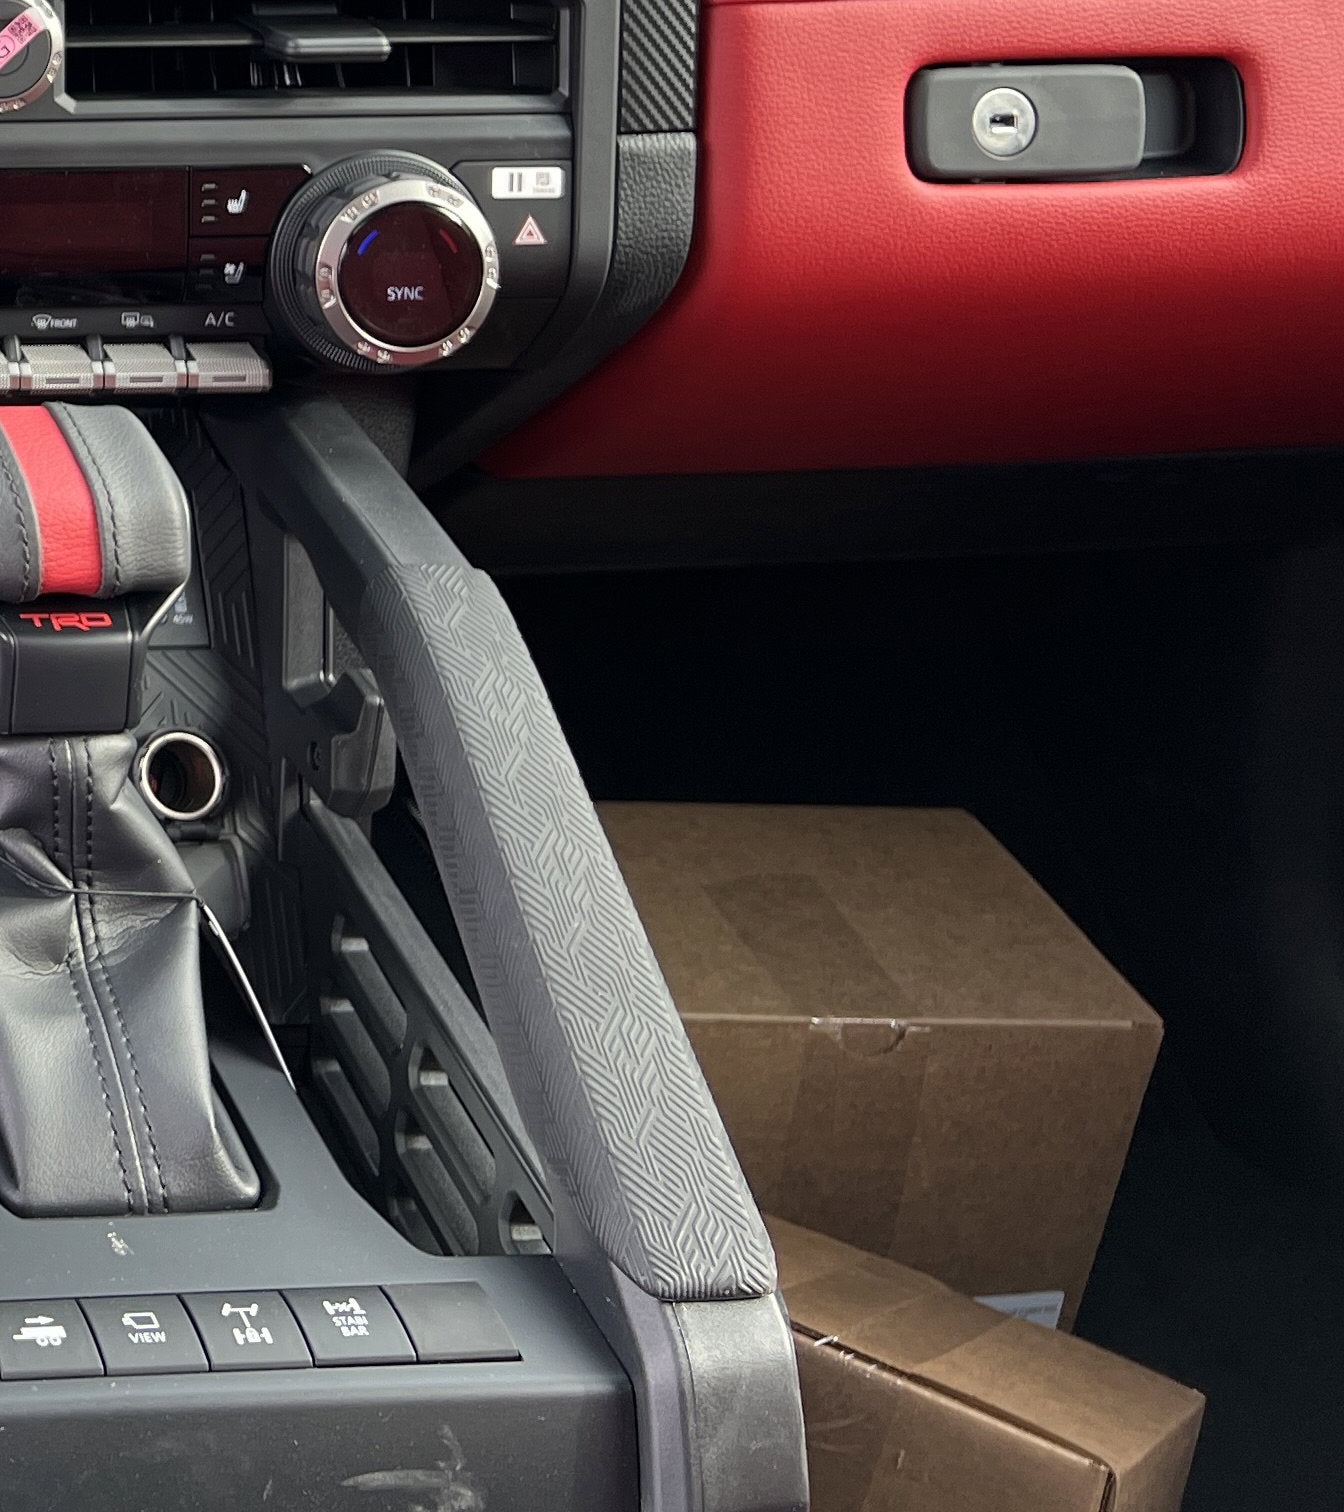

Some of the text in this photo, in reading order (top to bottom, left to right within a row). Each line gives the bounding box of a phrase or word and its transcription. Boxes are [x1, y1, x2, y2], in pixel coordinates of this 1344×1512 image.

[386, 286, 424, 303] SYNC
[49, 317, 78, 330] FRONT
[203, 311, 236, 329] A/C
[18, 611, 113, 633] TRD
[332, 1314, 369, 1329] STABI
[127, 1331, 167, 1345] VIEW
[341, 1324, 370, 1337] BAR
